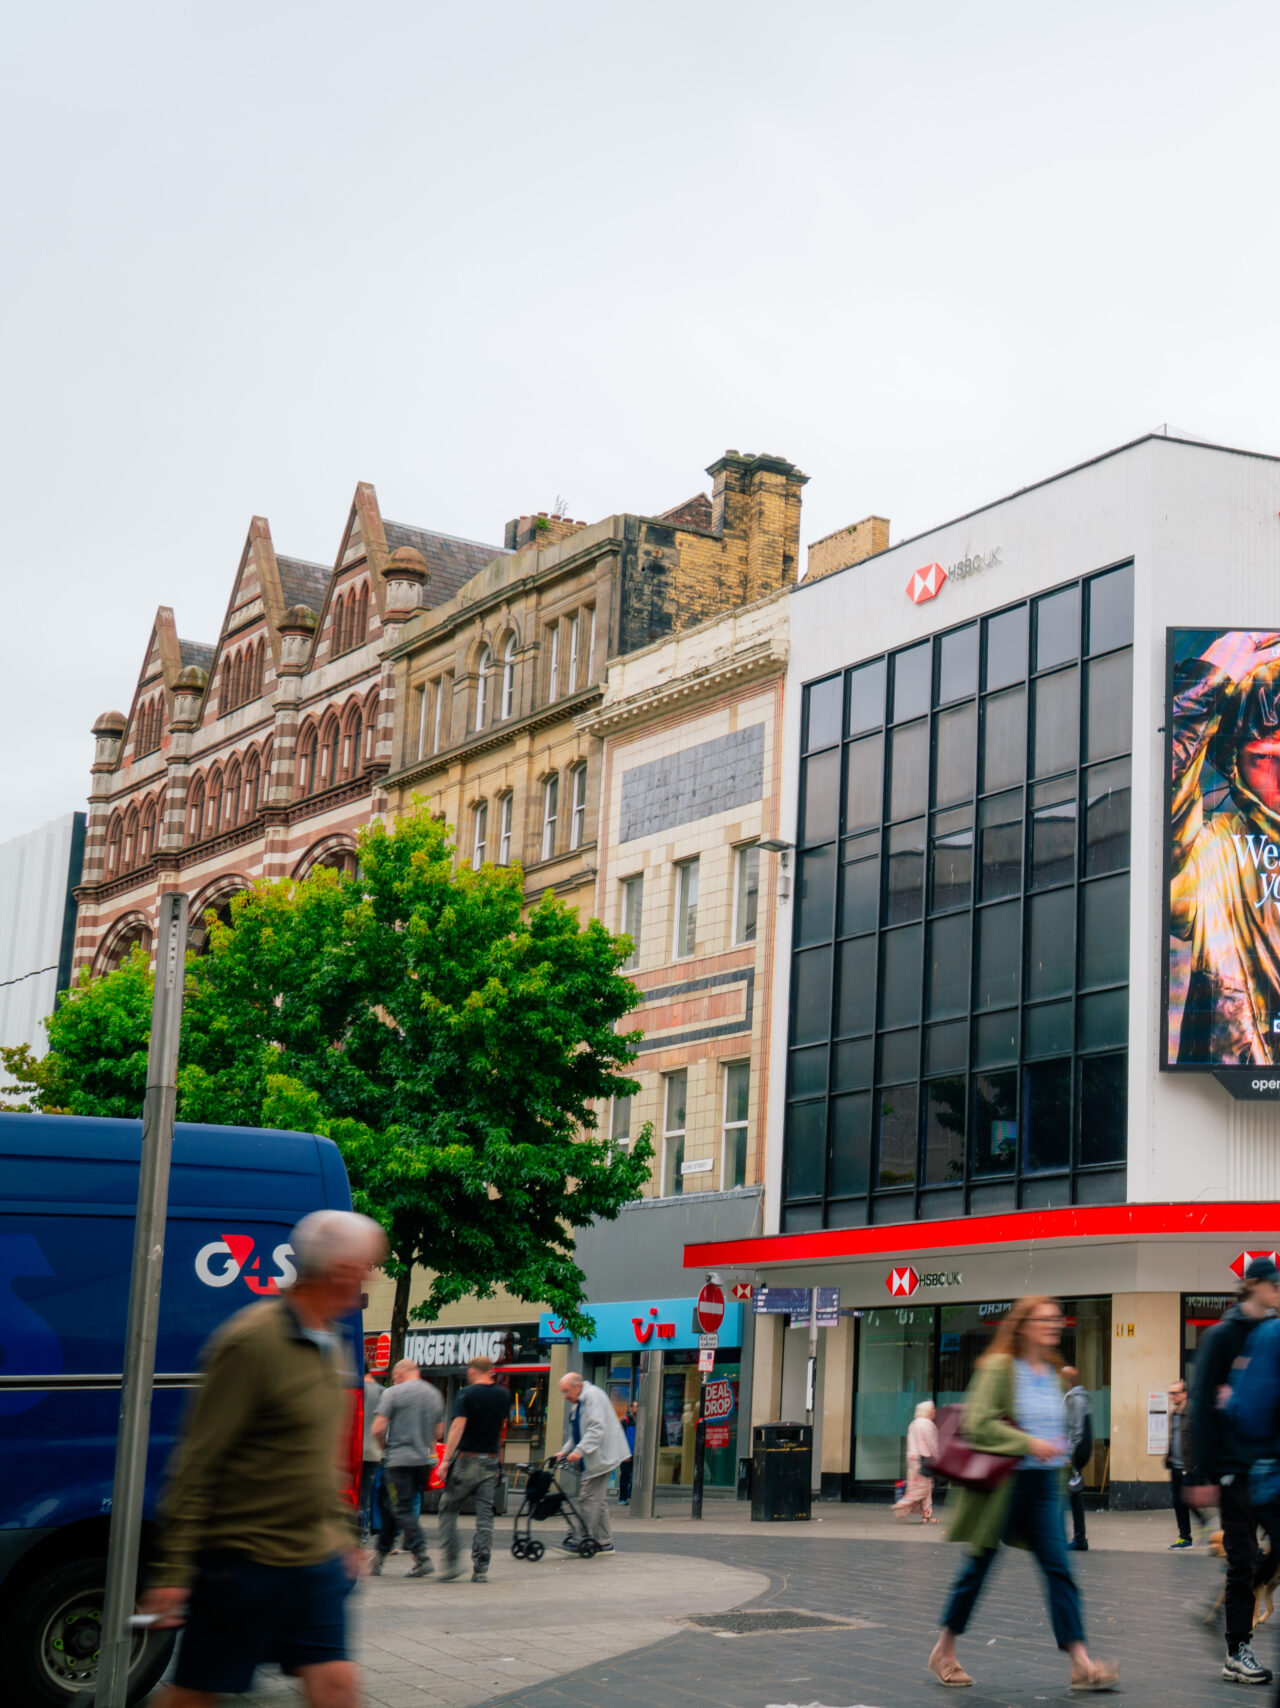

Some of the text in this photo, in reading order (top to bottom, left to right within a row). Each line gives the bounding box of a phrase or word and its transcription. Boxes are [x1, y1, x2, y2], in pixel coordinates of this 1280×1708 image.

[948, 546, 1002, 580] HSBC UK
[195, 1234, 298, 1295] G4S
[919, 1271, 961, 1287] HSBC UK
[656, 1323, 675, 1338] TUI
[404, 1333, 458, 1367] URGER
[457, 1331, 502, 1366] KING
[706, 1384, 729, 1400] DEAL
[705, 1398, 731, 1415] DROP
